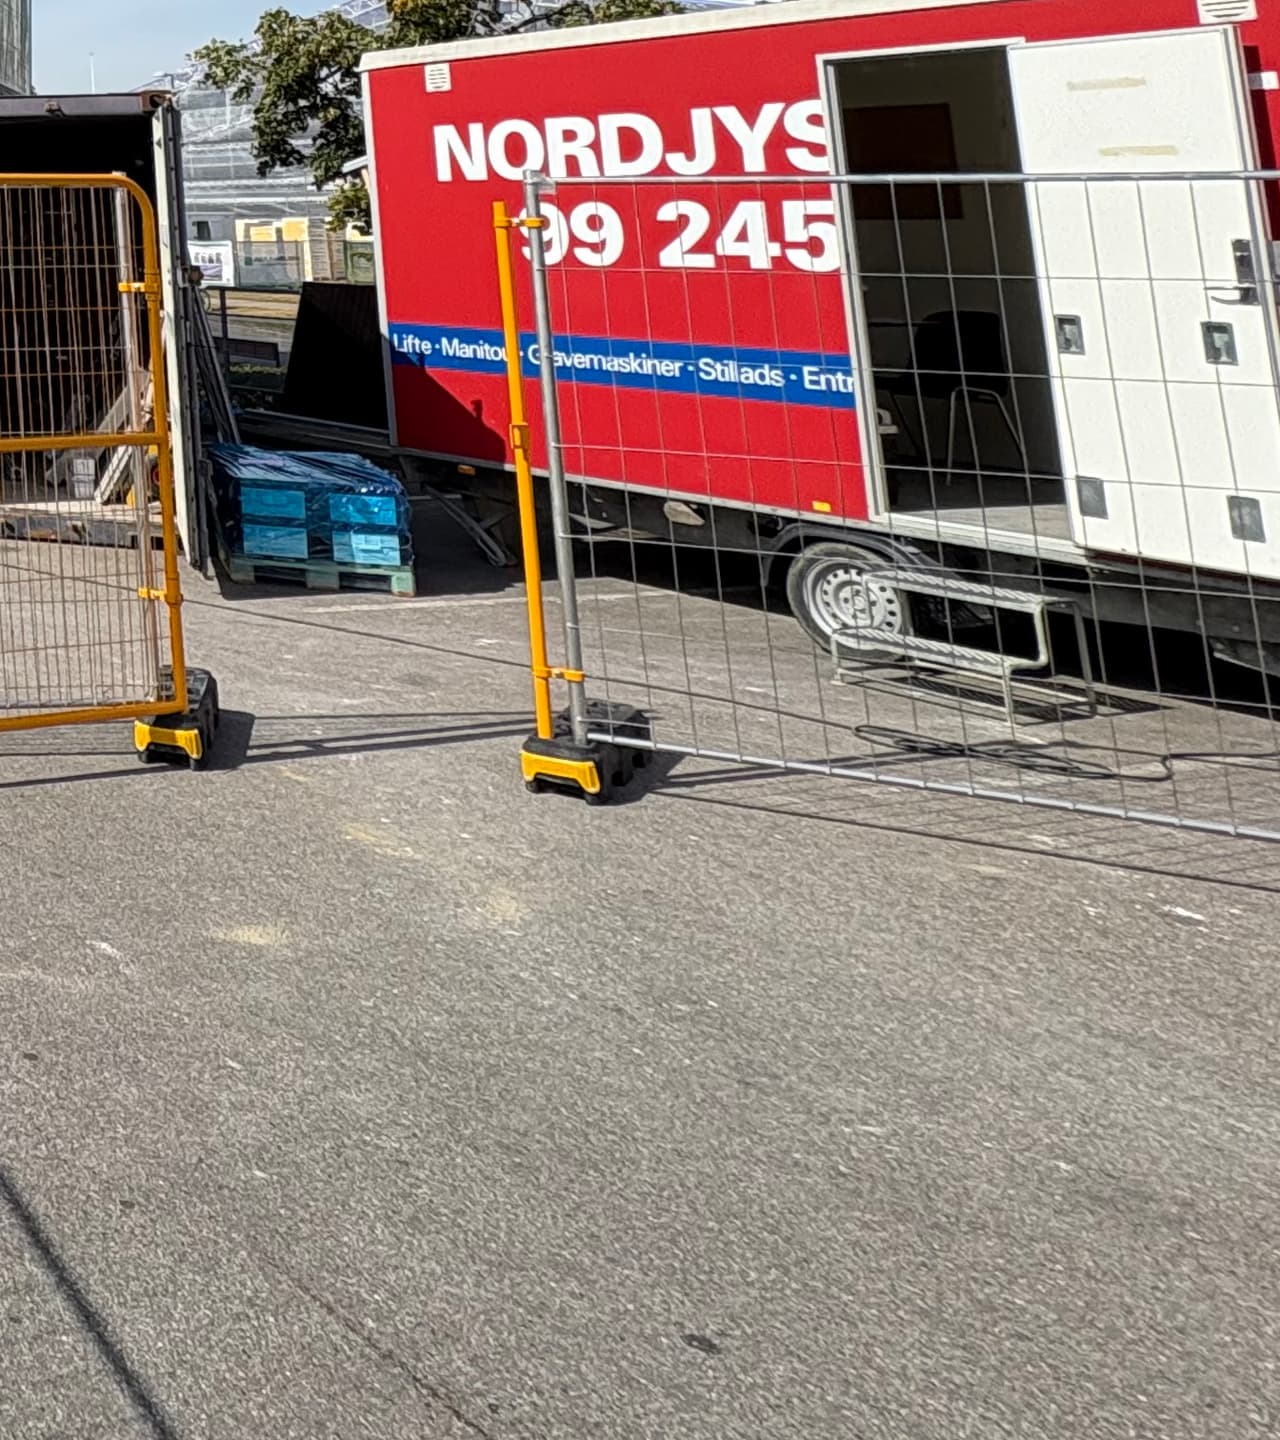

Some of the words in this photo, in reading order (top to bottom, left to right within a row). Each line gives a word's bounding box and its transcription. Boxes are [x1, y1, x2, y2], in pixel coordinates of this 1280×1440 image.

[432, 99, 831, 183] NORDJYS
[655, 199, 842, 273] 245
[393, 333, 432, 356] Lifte
[527, 343, 682, 379] Gavemaskiner
[698, 357, 784, 388] Stillads
